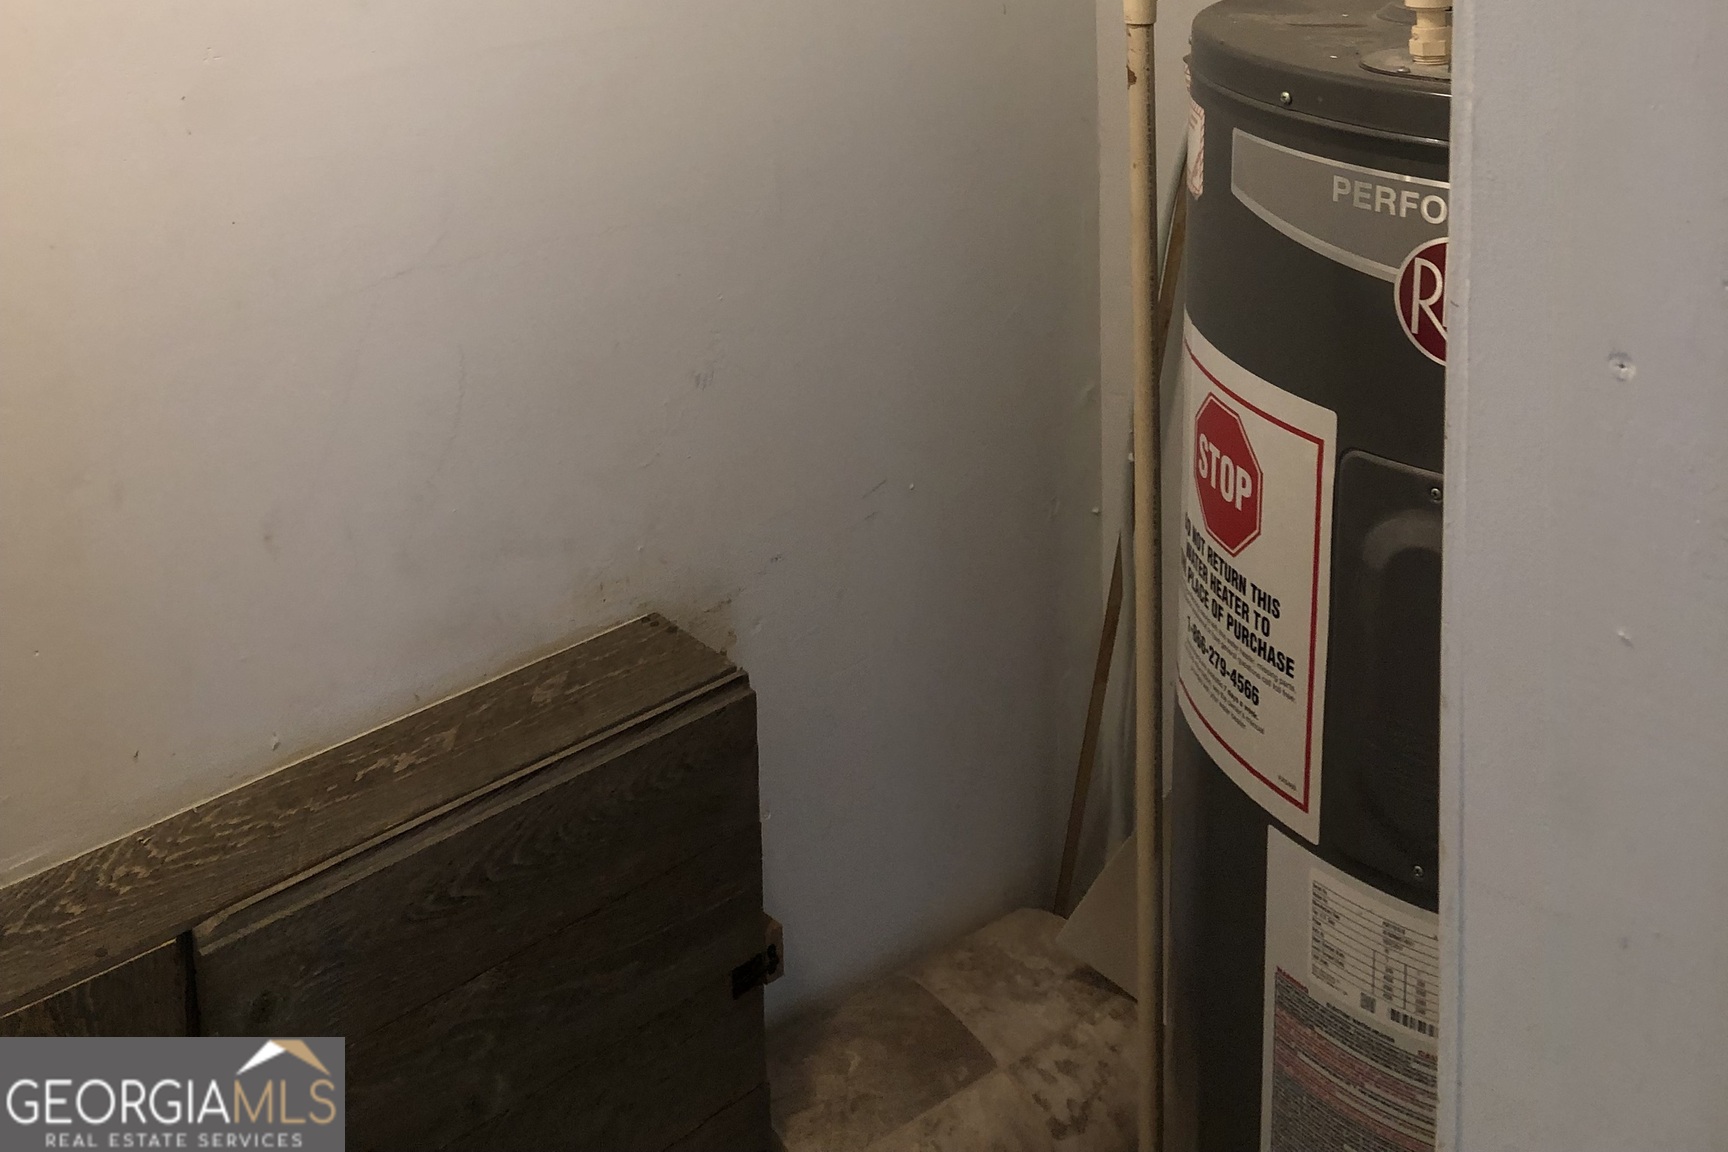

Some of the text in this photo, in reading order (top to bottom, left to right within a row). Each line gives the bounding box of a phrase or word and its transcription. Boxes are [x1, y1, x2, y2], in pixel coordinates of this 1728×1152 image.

[1332, 175, 1448, 225] PERFO
[1199, 433, 1252, 512] STOP
[1207, 545, 1247, 597] RETURN
[1250, 582, 1281, 619] THIS
[1210, 572, 1250, 623] HEATER
[1253, 610, 1271, 638] TO
[1187, 566, 1209, 610] PLACE
[1211, 598, 1224, 622] OF
[1226, 612, 1296, 679] PURCHASE
